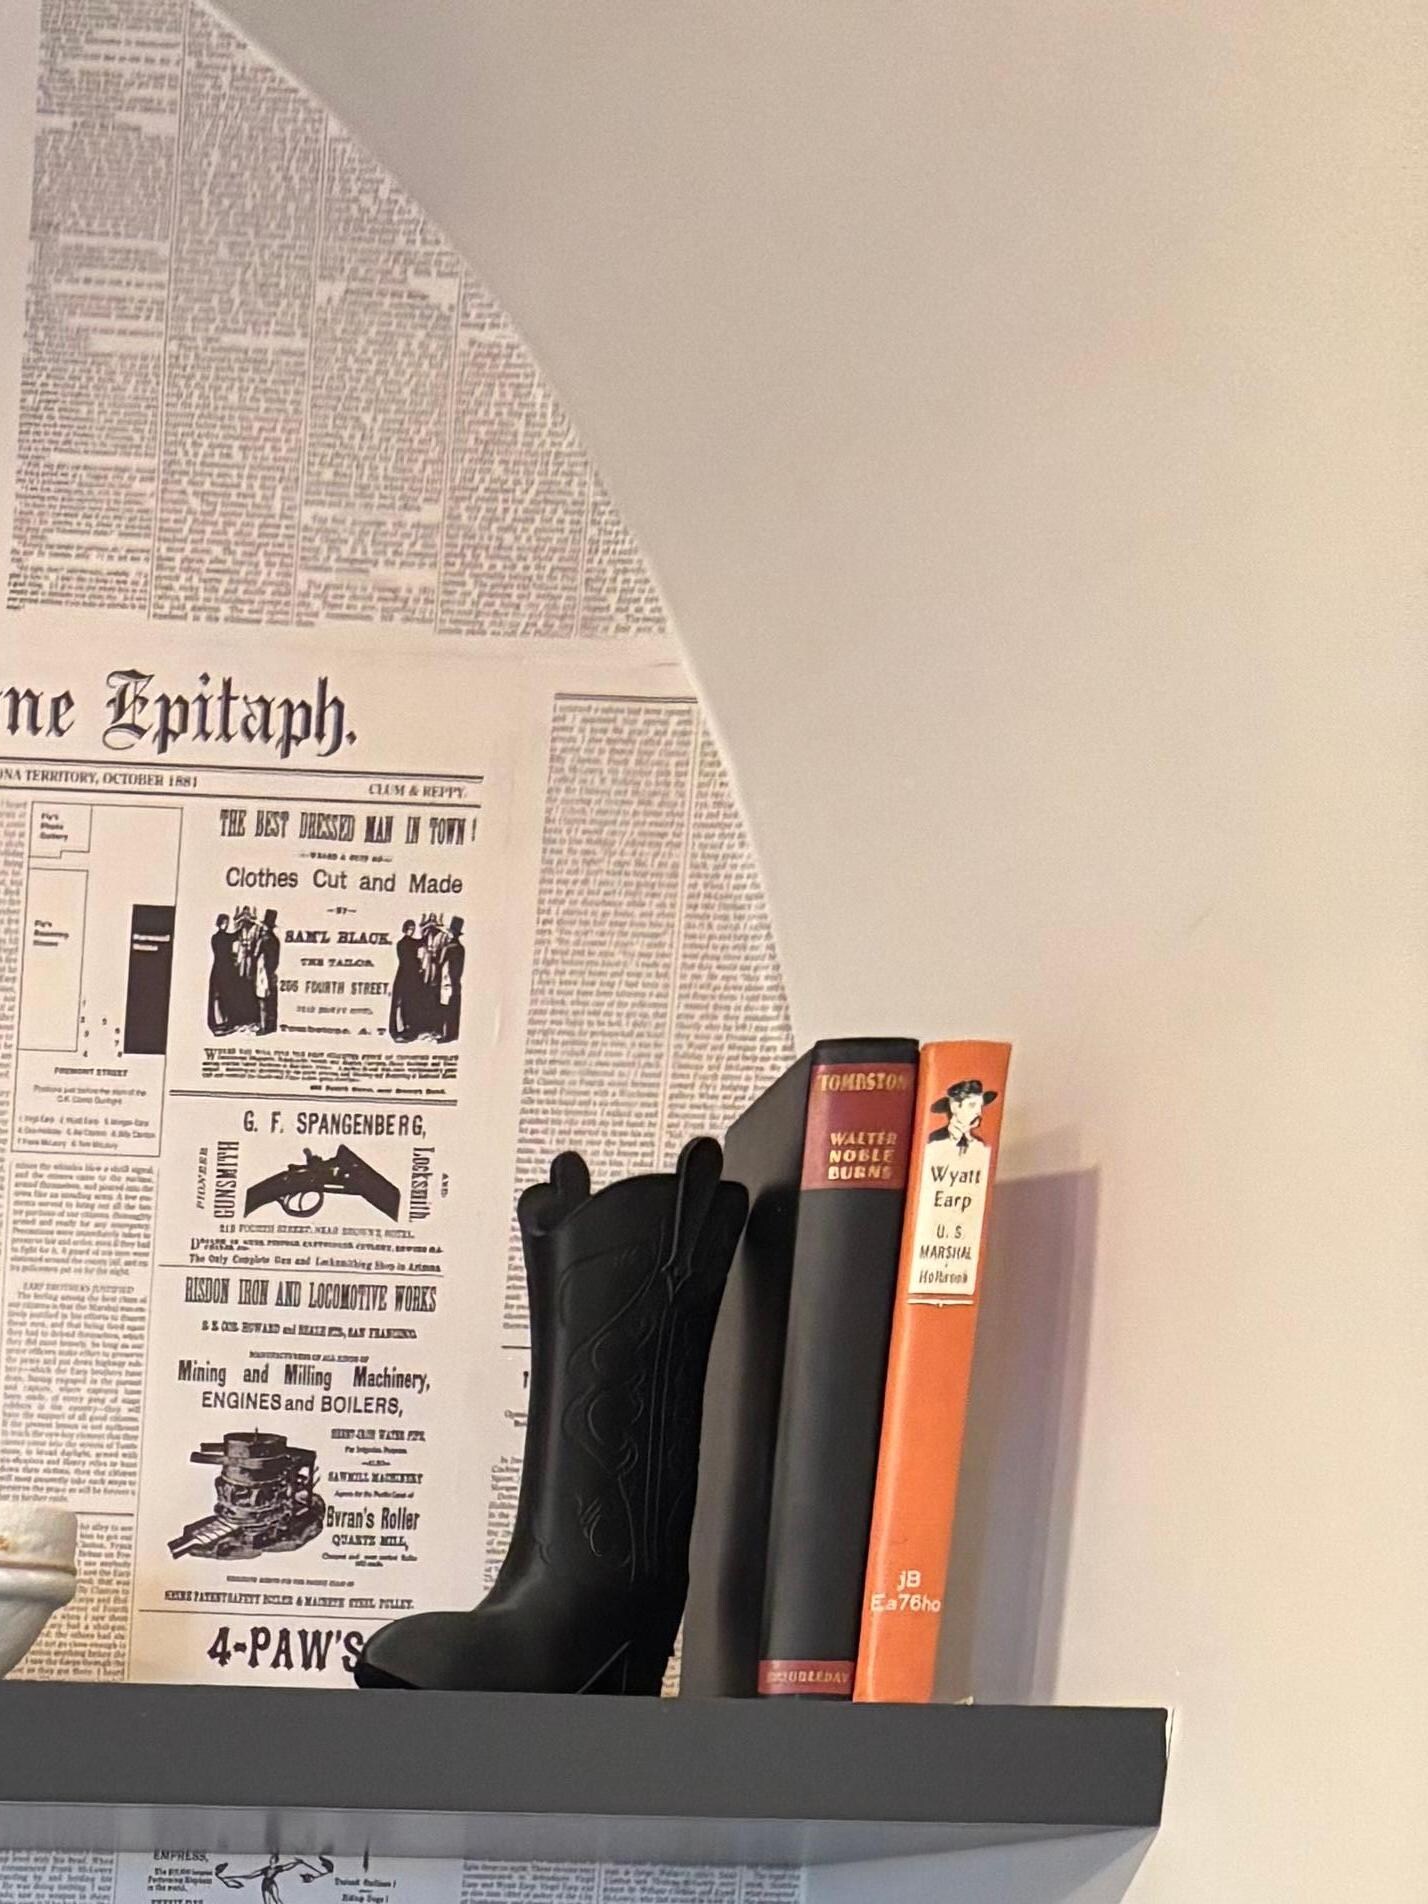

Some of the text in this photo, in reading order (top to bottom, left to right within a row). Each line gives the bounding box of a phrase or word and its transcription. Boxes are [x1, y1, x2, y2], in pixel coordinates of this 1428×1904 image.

[103, 668, 357, 758] Epitaph.
[103, 772, 163, 787] OCTOBER
[220, 809, 245, 836] THE
[256, 812, 289, 837] BEST
[299, 812, 355, 842] DRESSED
[406, 816, 419, 843] IN
[226, 867, 463, 893] Clothes Cut and Made
[243, 1111, 426, 1138] G. F. SPANGENBERG,
[828, 1131, 897, 1146] WALTER
[828, 1147, 894, 1165] NOBLE
[214, 1141, 240, 1218] GUNSMITH
[828, 1163, 891, 1180] BURNS
[931, 1164, 981, 1186] Wyatt
[934, 1191, 971, 1212] Earp
[920, 1244, 971, 1260] MARSHAL
[185, 1276, 437, 1311] RISDON IRON AND LOCOMOTIVE WORKS
[178, 1360, 431, 1391] Mining and Milling Machinery,
[202, 1392, 403, 1417] ENGINES and BOILERS,
[207, 1626, 367, 1672] 4-PAW'S
